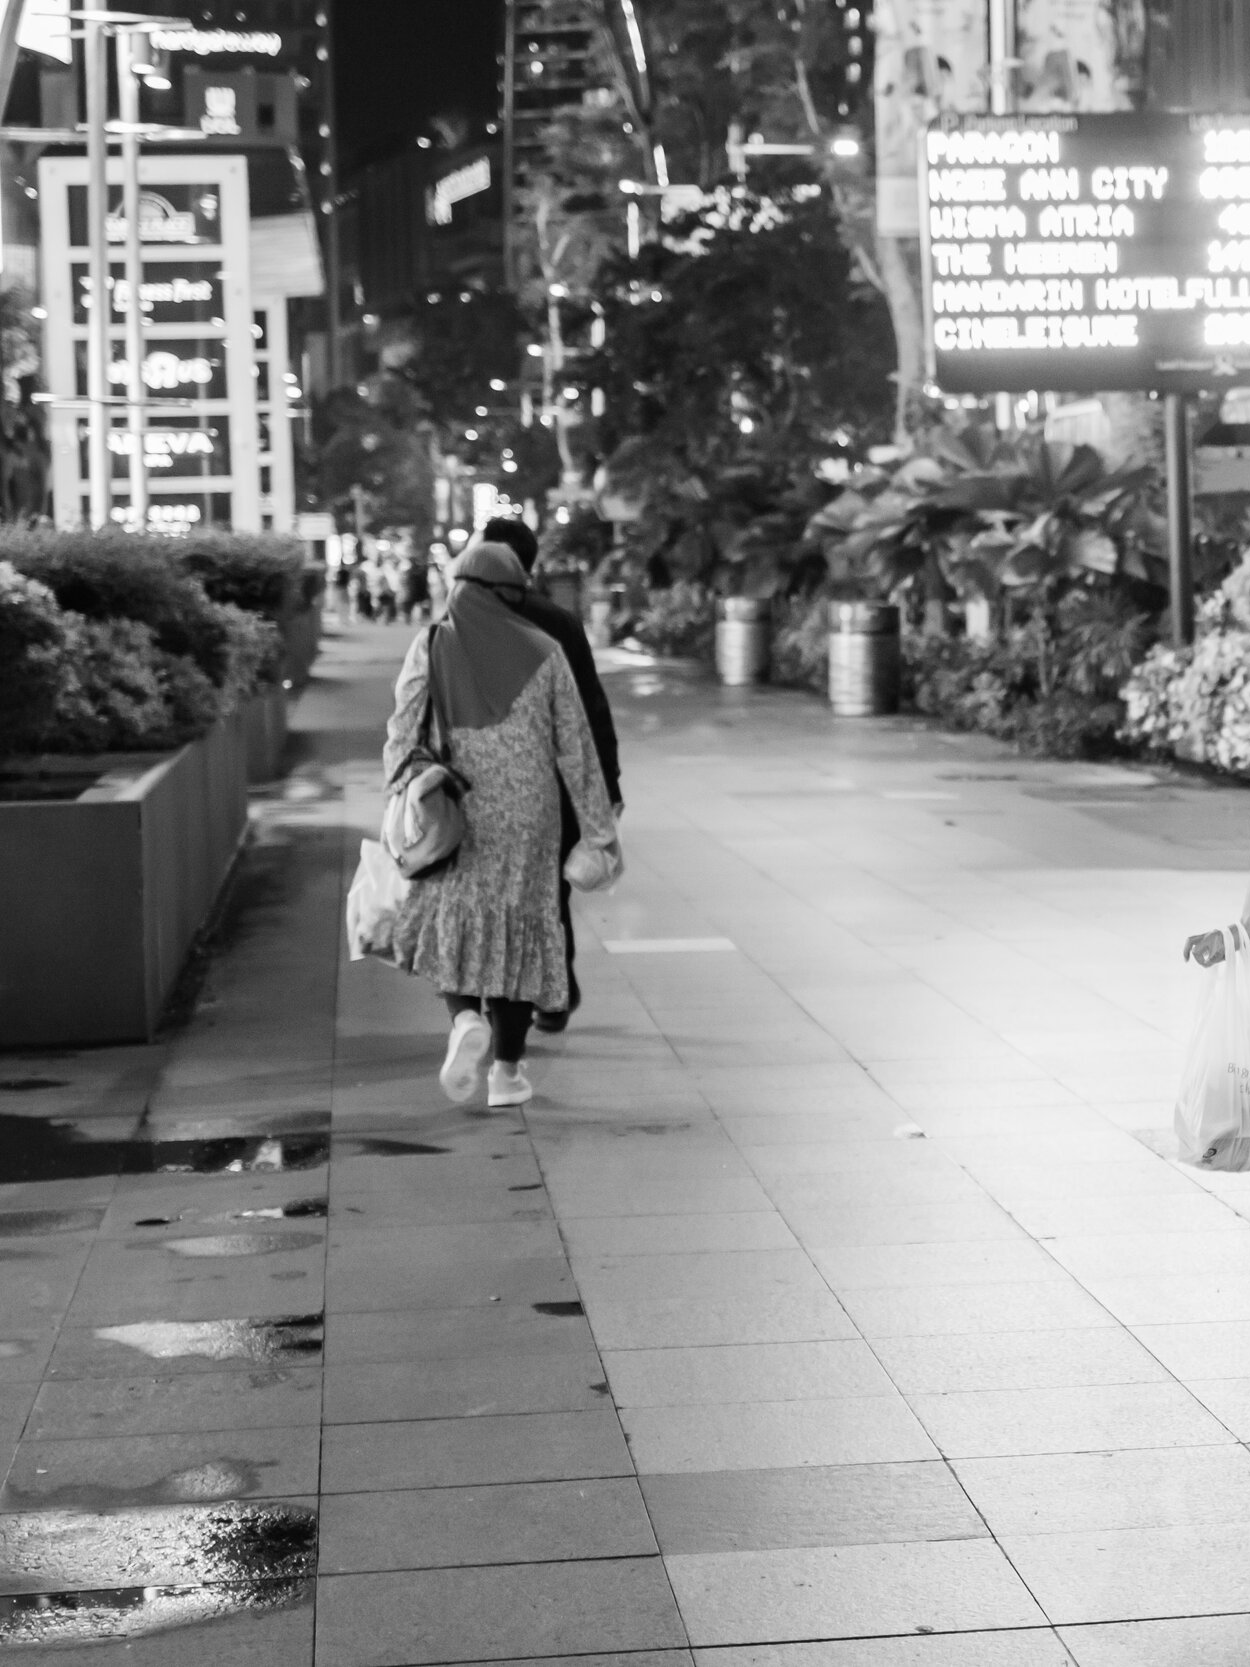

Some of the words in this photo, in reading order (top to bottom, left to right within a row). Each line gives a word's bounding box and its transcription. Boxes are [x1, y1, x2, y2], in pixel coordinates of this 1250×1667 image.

[927, 131, 1060, 164] PARAGON
[1020, 168, 1079, 200] ANN
[1092, 167, 1167, 199] CITY
[927, 206, 1026, 238] WISMA
[1039, 205, 1134, 237] ATRIA
[932, 244, 991, 275] THE
[933, 279, 1083, 312] MANDARIN
[1096, 277, 1186, 310] HOTEL
[935, 315, 1138, 350] CINELEISURE
